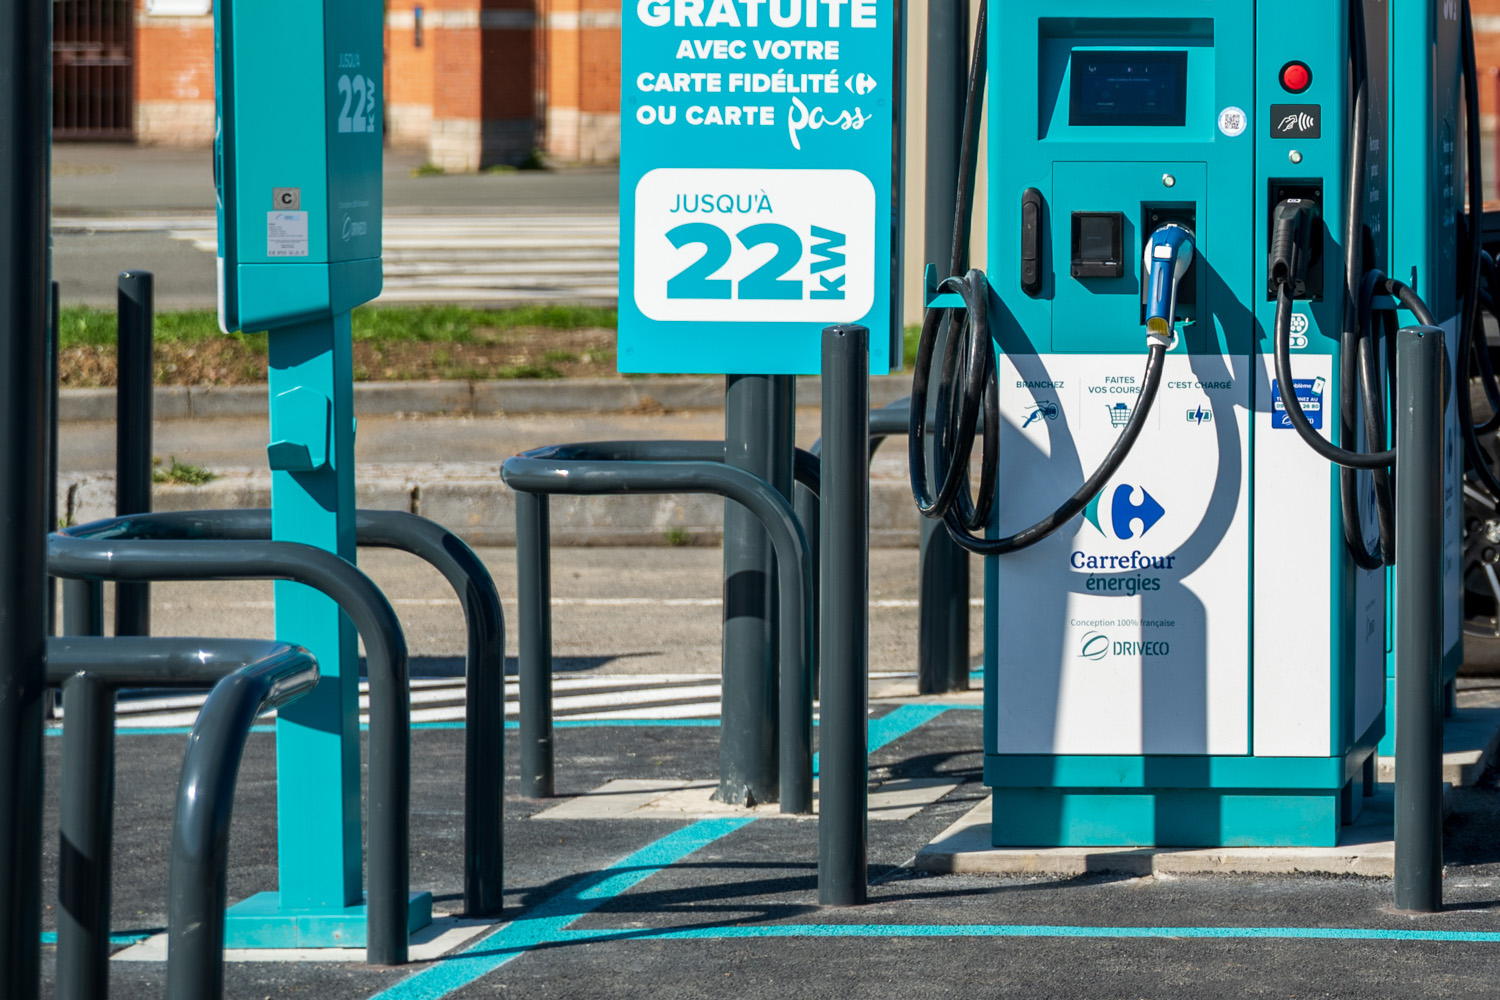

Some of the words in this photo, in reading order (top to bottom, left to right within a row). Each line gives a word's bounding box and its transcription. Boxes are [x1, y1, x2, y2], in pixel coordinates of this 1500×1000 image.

[676, 40, 747, 60] AVEC
[753, 40, 839, 60] VOTRE
[636, 72, 721, 92] CARTE
[729, 68, 839, 93] FIDÉLITÉ
[338, 74, 366, 133] 22
[636, 105, 677, 125] OU
[685, 105, 775, 126] CARTE
[788, 96, 873, 151] pass
[281, 193, 292, 204] C
[670, 189, 774, 214] JUSQU'À
[664, 222, 803, 301] 22
[810, 224, 846, 300] kW
[1016, 380, 1064, 389] BRANCHEZ
[1105, 376, 1135, 384] FAITES
[1168, 381, 1193, 389] C'EST
[1195, 379, 1232, 389] CHARGÉ
[1088, 386, 1107, 394] VOS
[1109, 386, 1141, 394] COURS
[1070, 550, 1176, 569] Carrefour
[1086, 572, 1161, 597] énergies
[1070, 618, 1115, 628] Conception
[1117, 619, 1139, 627] 100%
[1140, 618, 1175, 628] française
[1113, 641, 1170, 656] DRIVECO
